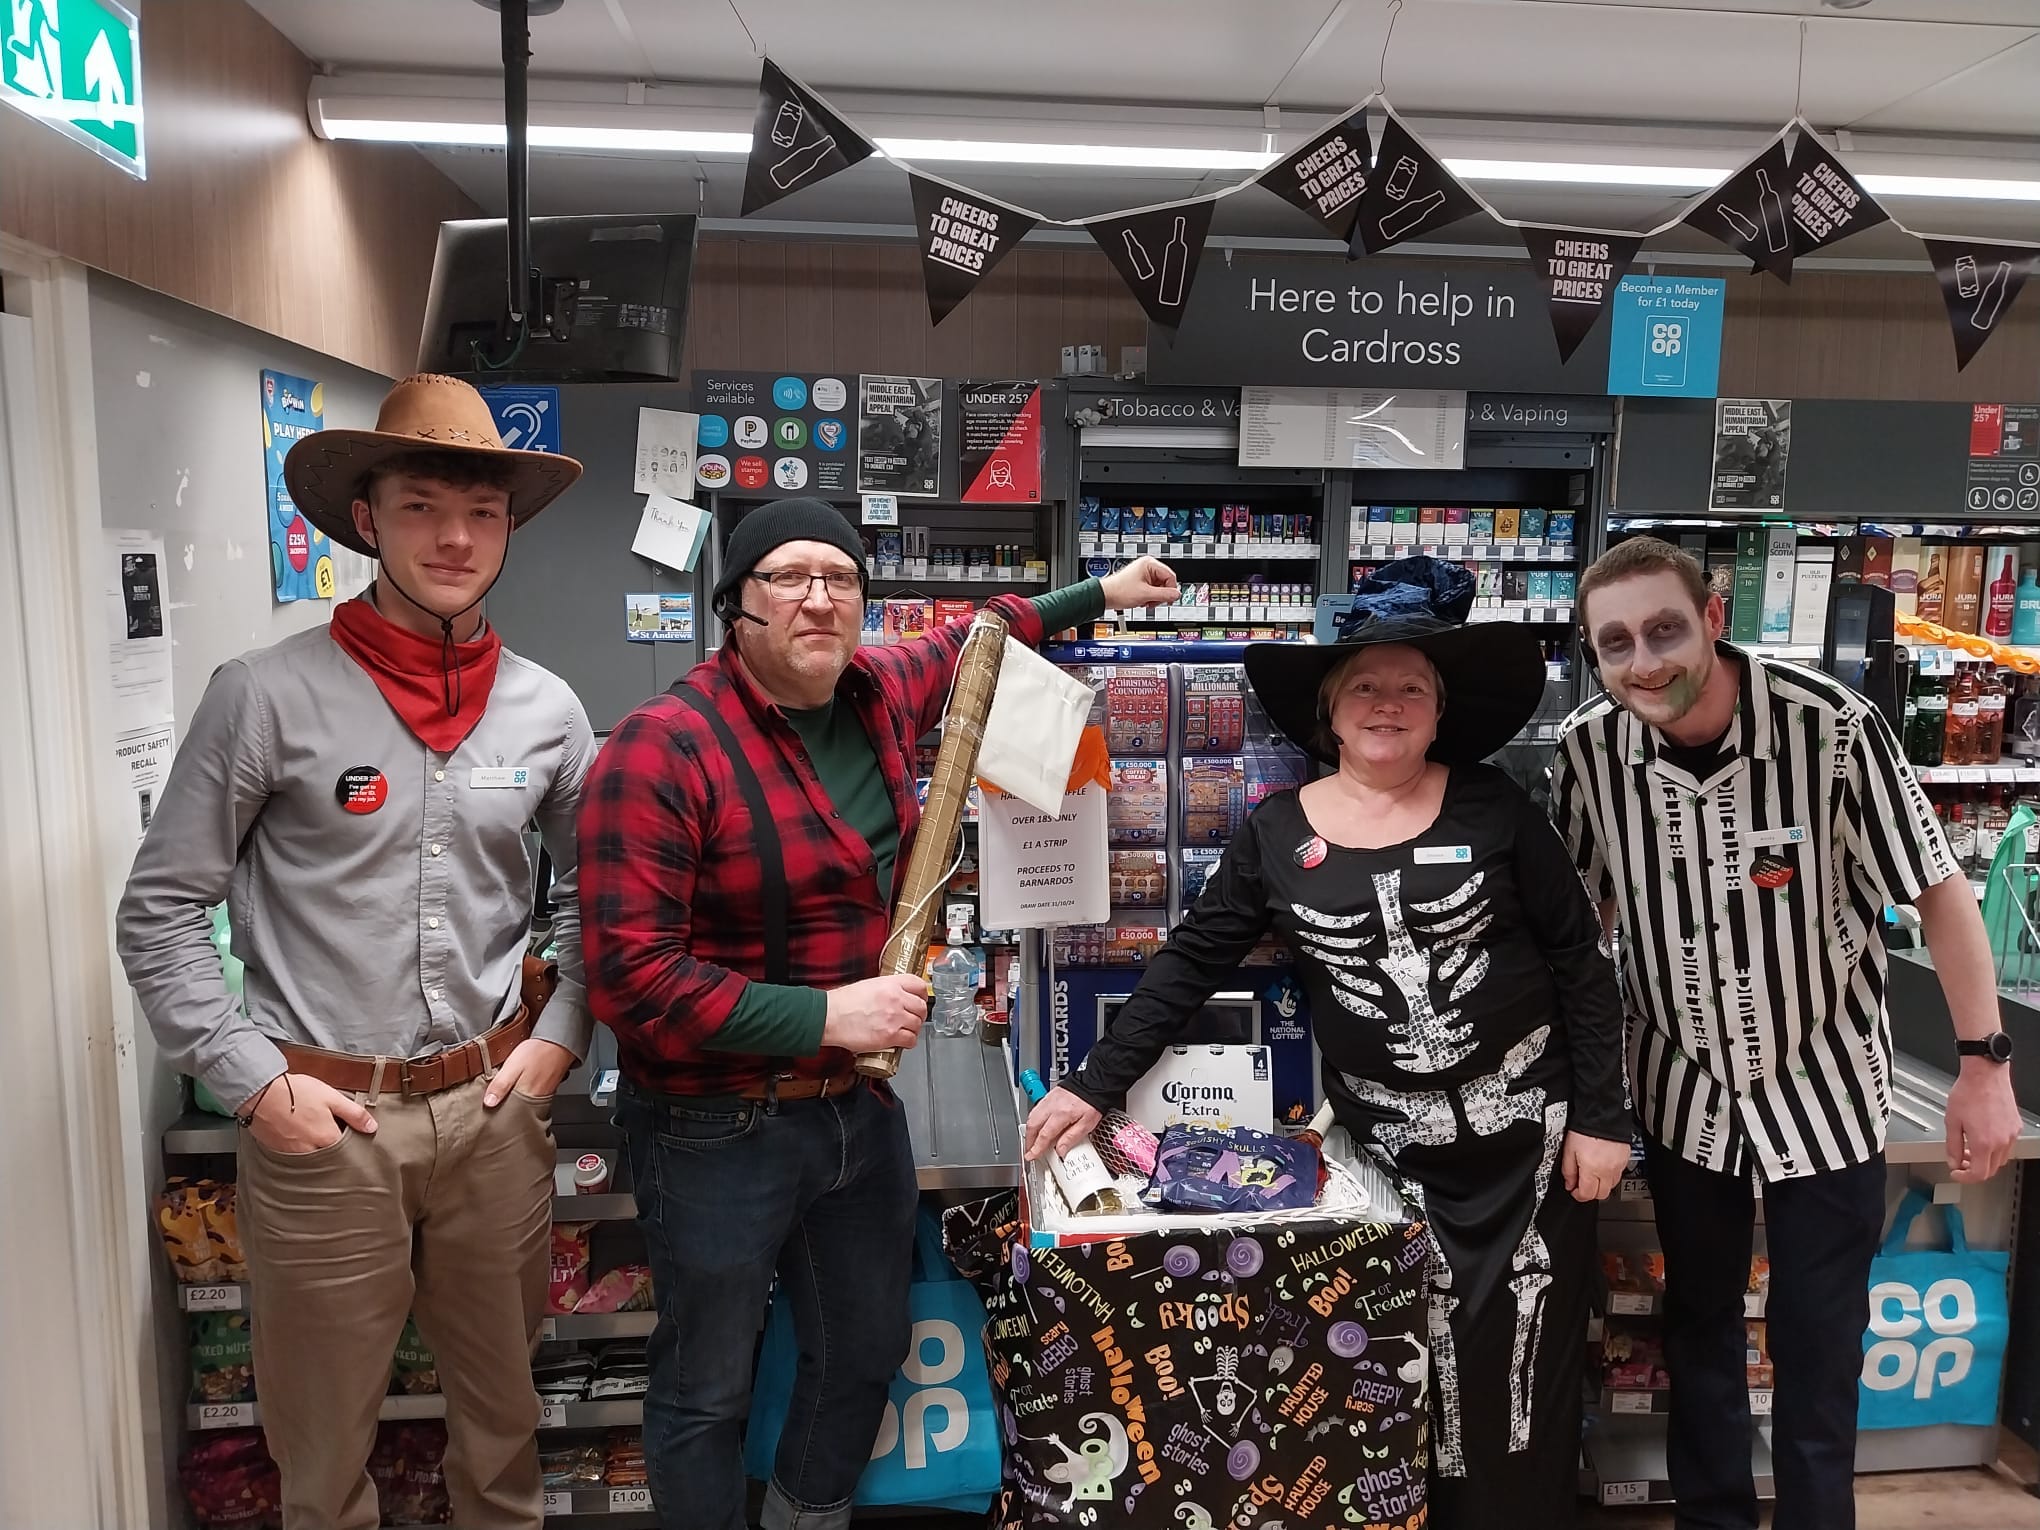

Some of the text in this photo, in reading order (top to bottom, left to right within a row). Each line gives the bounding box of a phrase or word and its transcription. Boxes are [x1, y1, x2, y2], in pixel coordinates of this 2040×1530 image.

[1294, 135, 1348, 180] CHEERS
[1299, 149, 1363, 201] TO GREAT
[1317, 171, 1366, 214] PRICES
[1812, 162, 1860, 210] CHEERS
[1795, 172, 1853, 230] TO GREAT
[940, 197, 999, 231] CHEERS
[1790, 193, 1829, 239] PRICES
[930, 213, 999, 253] TO GREAT
[929, 236, 985, 270] PRICES
[1554, 239, 1610, 261] CHEERS
[1547, 257, 1613, 281] TO GREAT
[1552, 279, 1603, 300] PRICES
[1621, 282, 1719, 298] Become a Member
[1250, 278, 1515, 326] Here to help in
[1638, 297, 1700, 311] for £1 today
[1301, 329, 1461, 365] Cardross
[707, 379, 754, 391] Services
[869, 384, 909, 395] MIDDLE EAST
[706, 392, 755, 404] available
[869, 394, 914, 404] HUMANITARIAN
[869, 404, 892, 412] APPEAL
[966, 394, 1029, 404] UNDER 25?
[1111, 398, 1216, 418] Tobacco &
[1480, 403, 1568, 426] & Vaping
[1725, 408, 1762, 416] MIDDLE EAST
[1974, 405, 1998, 414] Under
[1974, 414, 1989, 422] 25?
[274, 422, 294, 438] PLAY
[1724, 416, 1767, 426] HUMANITARIAN
[1724, 425, 1746, 434] APPEAL
[289, 533, 306, 546] £25K
[320, 570, 332, 587] £1
[1955, 593, 1977, 601] JURA
[652, 631, 692, 640] Andrews
[1114, 687, 1159, 695] COUNTDOWN
[1116, 679, 1157, 687] CHRISTMAS
[1191, 682, 1239, 691] MILLIONAIRE
[116, 738, 170, 758] PRODUCT SAFETY
[131, 757, 157, 770] RECALL
[1012, 816, 1035, 825] OVER
[1022, 839, 1068, 849] £1 A STRIP
[1017, 863, 1075, 875] PROCEEDS TO
[1019, 876, 1074, 888] BARNARDOS
[1020, 902, 1036, 910] DRAW
[1681, 937, 1709, 1049] BEETLEJUICE
[1735, 967, 1764, 1080] BEETLEJUICE
[1257, 1059, 1264, 1069] 4
[1162, 1081, 1234, 1104] Corona
[1182, 1102, 1220, 1116] Extra
[1184, 1136, 1266, 1153] SQUISHY SKULLS
[1290, 1222, 1395, 1274] HALLOWEEN!
[190, 1288, 226, 1301] £2.20
[1307, 1266, 1358, 1318] BOO!
[1378, 1282, 1392, 1296] or
[1354, 1289, 1412, 1321] Treat
[1040, 1321, 1070, 1345] scary
[1033, 1335, 1079, 1377] CREEPY
[1077, 1367, 1095, 1397] ghost
[1144, 1343, 1185, 1401] BOO!
[1064, 1367, 1075, 1404] stories
[1278, 1362, 1325, 1417] HAUNTED
[1352, 1378, 1403, 1407] CREEPY
[203, 1406, 238, 1418] £2.20
[1010, 1388, 1054, 1417] Treat
[1090, 1325, 1162, 1486] halloween
[1292, 1385, 1329, 1428] HOUSE
[1345, 1395, 1375, 1413] scary
[1167, 1422, 1211, 1453] ghost
[1161, 1443, 1210, 1476] stories
[1284, 1455, 1328, 1513] HAUNTED
[1357, 1457, 1413, 1501] ghost
[612, 1491, 646, 1502] £1.00
[1297, 1479, 1332, 1520] HOUSE
[1368, 1478, 1426, 1520] stories
[1607, 1484, 1637, 1495] £1.15
